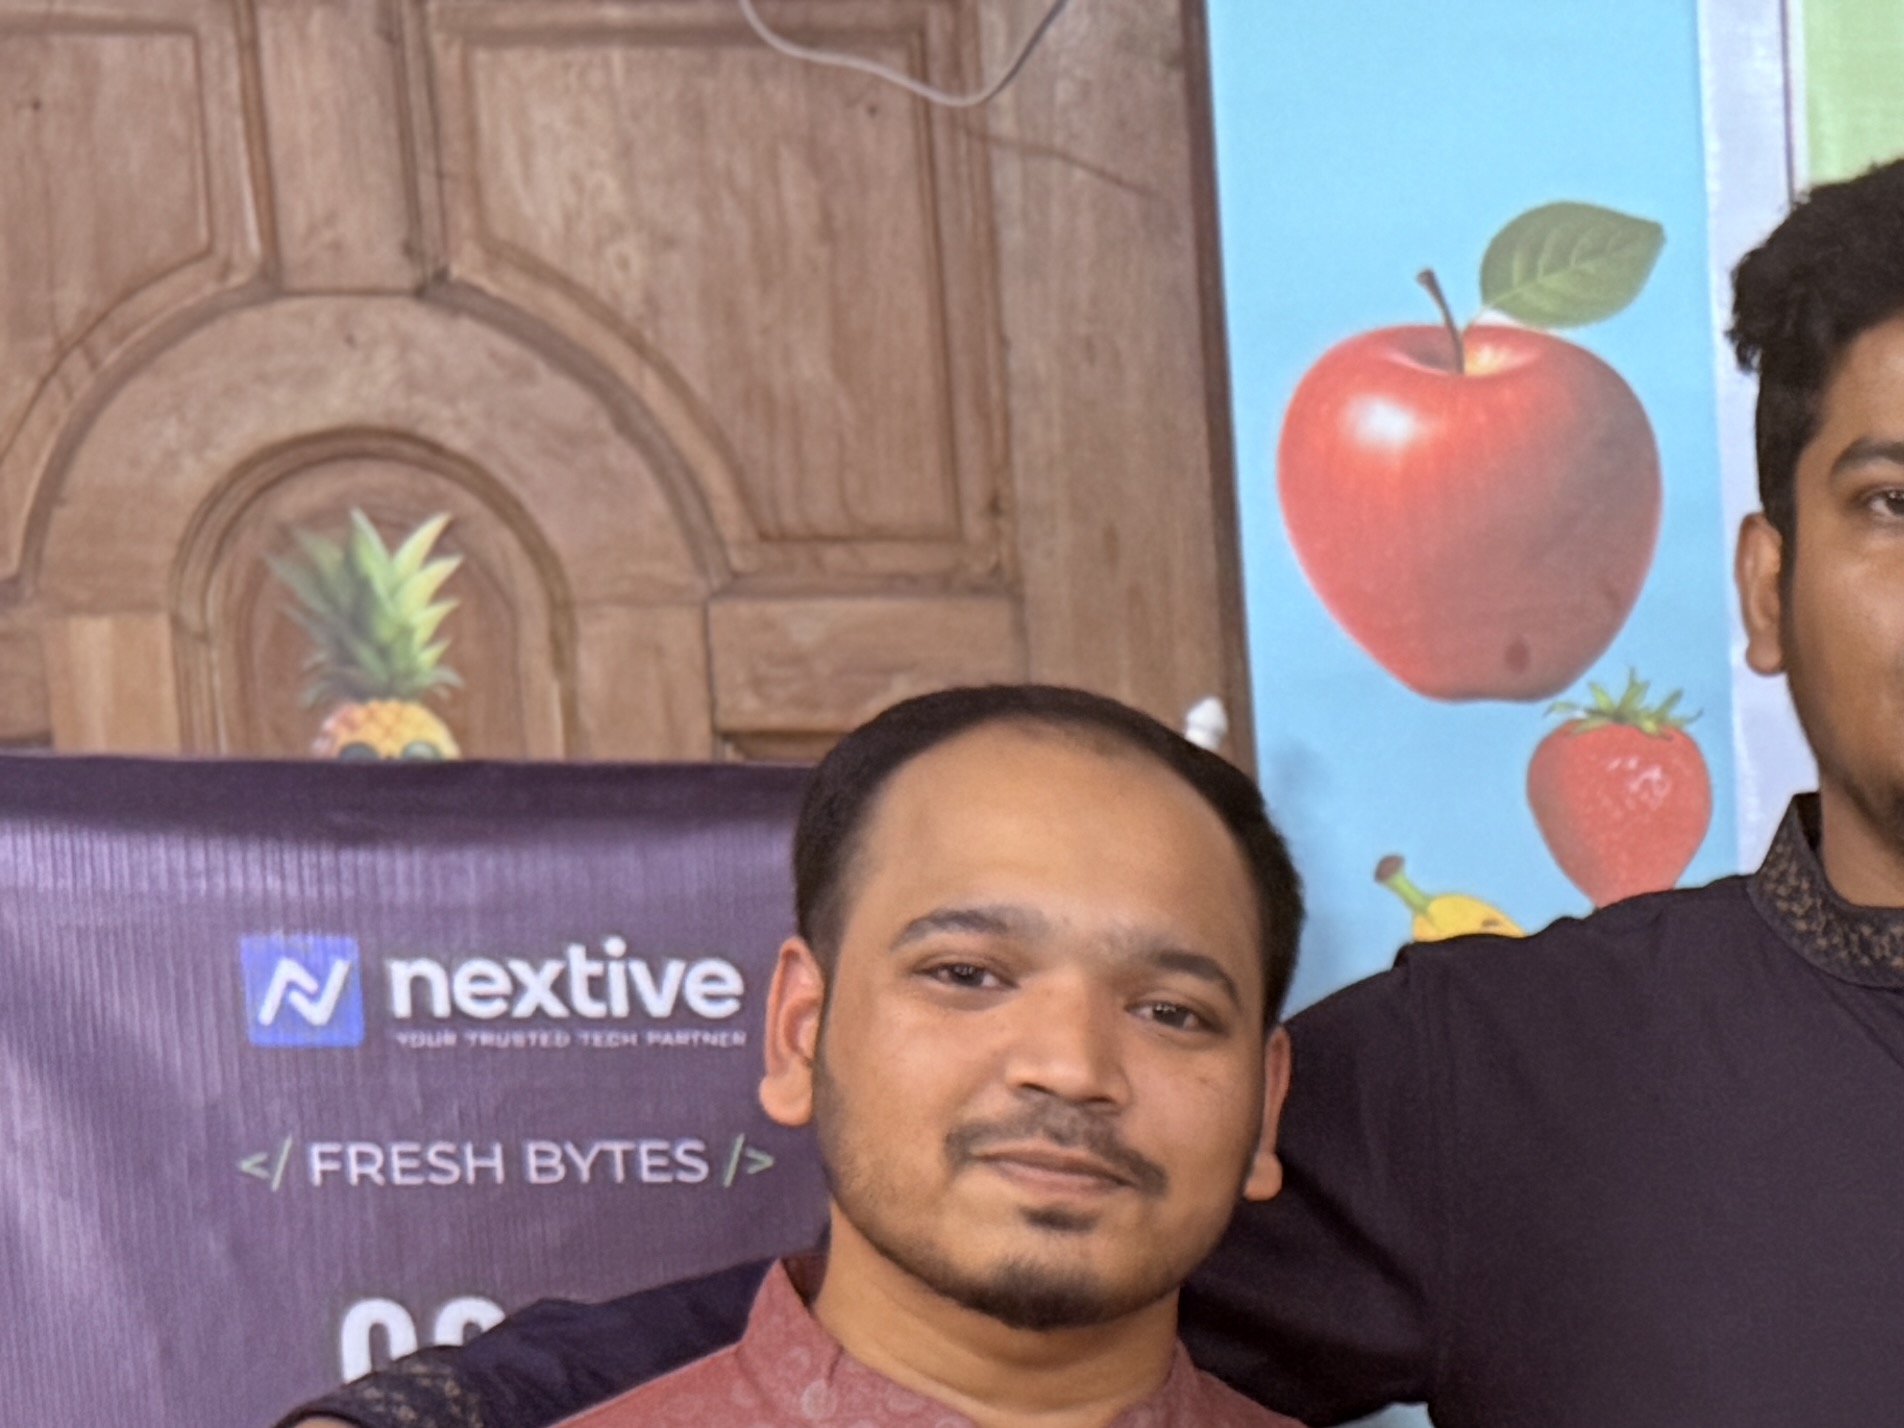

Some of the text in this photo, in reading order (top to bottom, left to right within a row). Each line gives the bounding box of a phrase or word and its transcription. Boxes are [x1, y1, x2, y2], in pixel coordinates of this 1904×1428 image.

[387, 936, 746, 1019] nextive
[399, 1030, 747, 1048] YOUR TRUSTED TECH PARTNER
[309, 1142, 505, 1187] FRESH
[526, 1140, 709, 1184] BYTES
